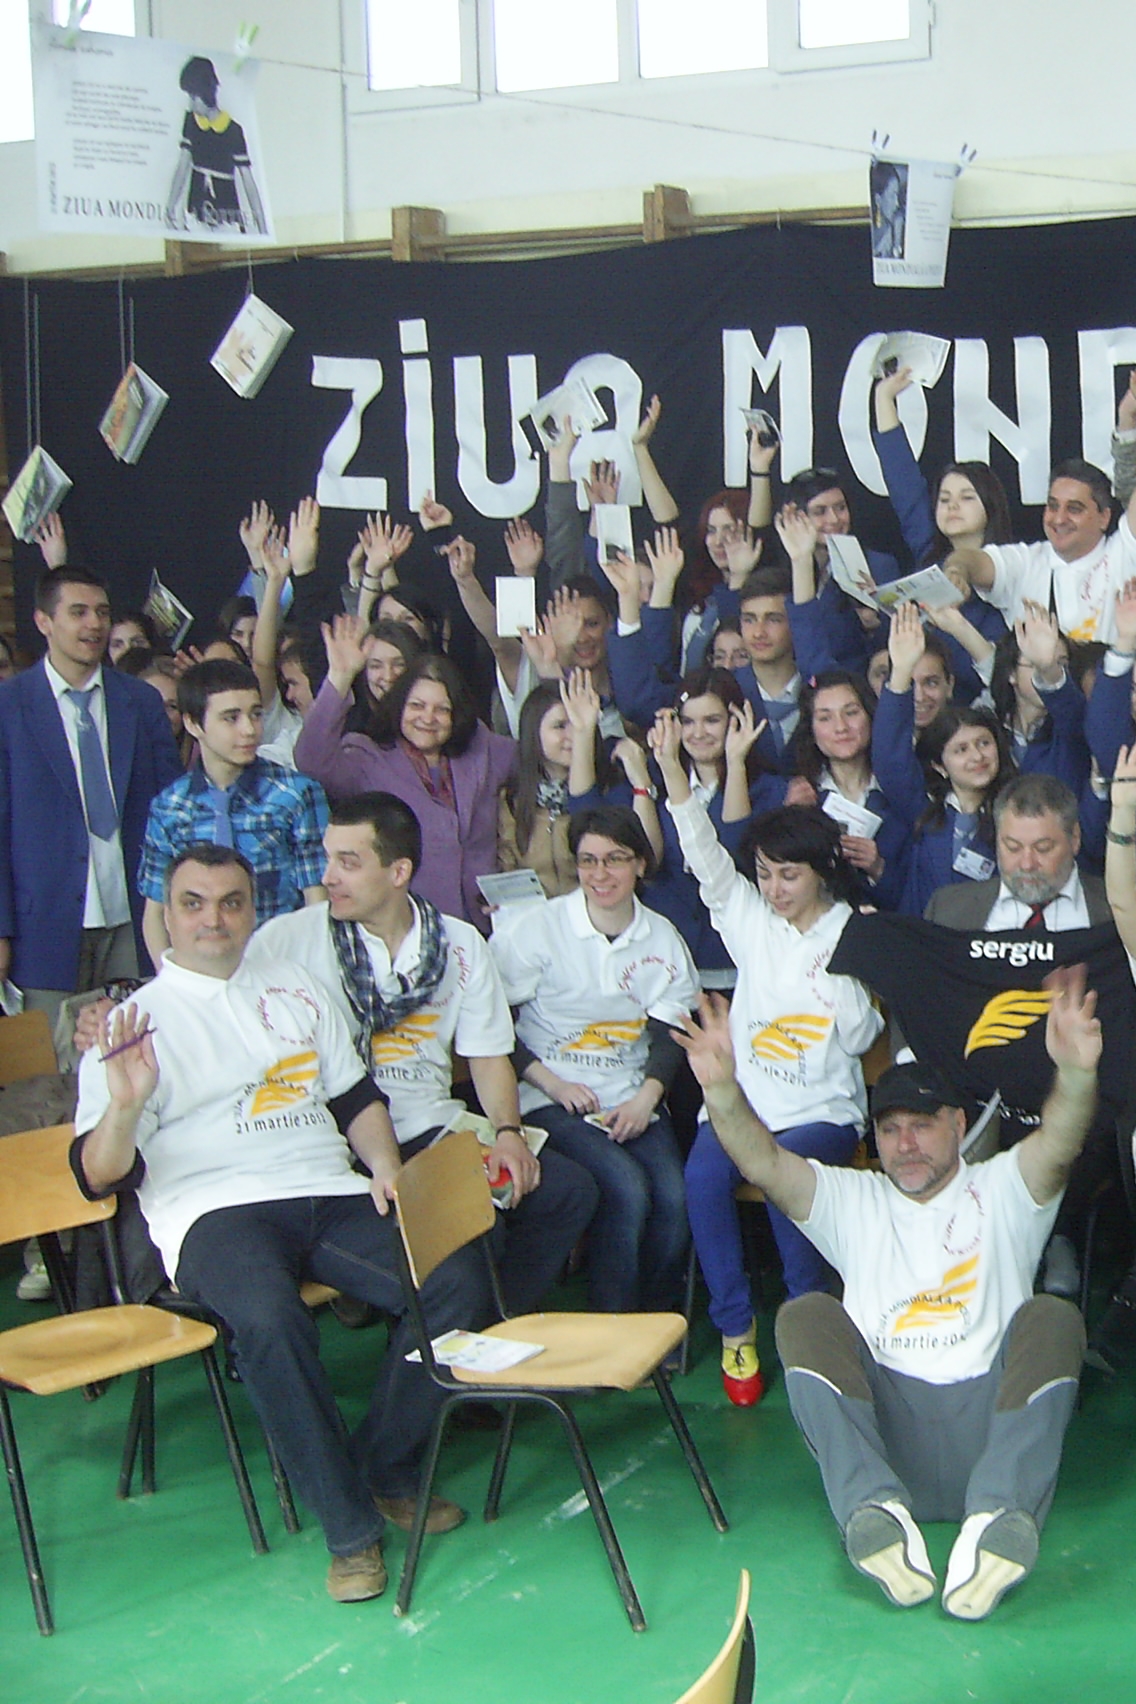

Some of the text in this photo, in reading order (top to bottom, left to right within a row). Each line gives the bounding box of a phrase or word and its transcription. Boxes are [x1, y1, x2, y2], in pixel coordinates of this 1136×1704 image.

[63, 195, 104, 217] ZIUA
[969, 939, 1054, 967] sergiu
[235, 1121, 250, 1134] 21
[254, 1111, 301, 1132] martie
[890, 1331, 938, 1349] martie
